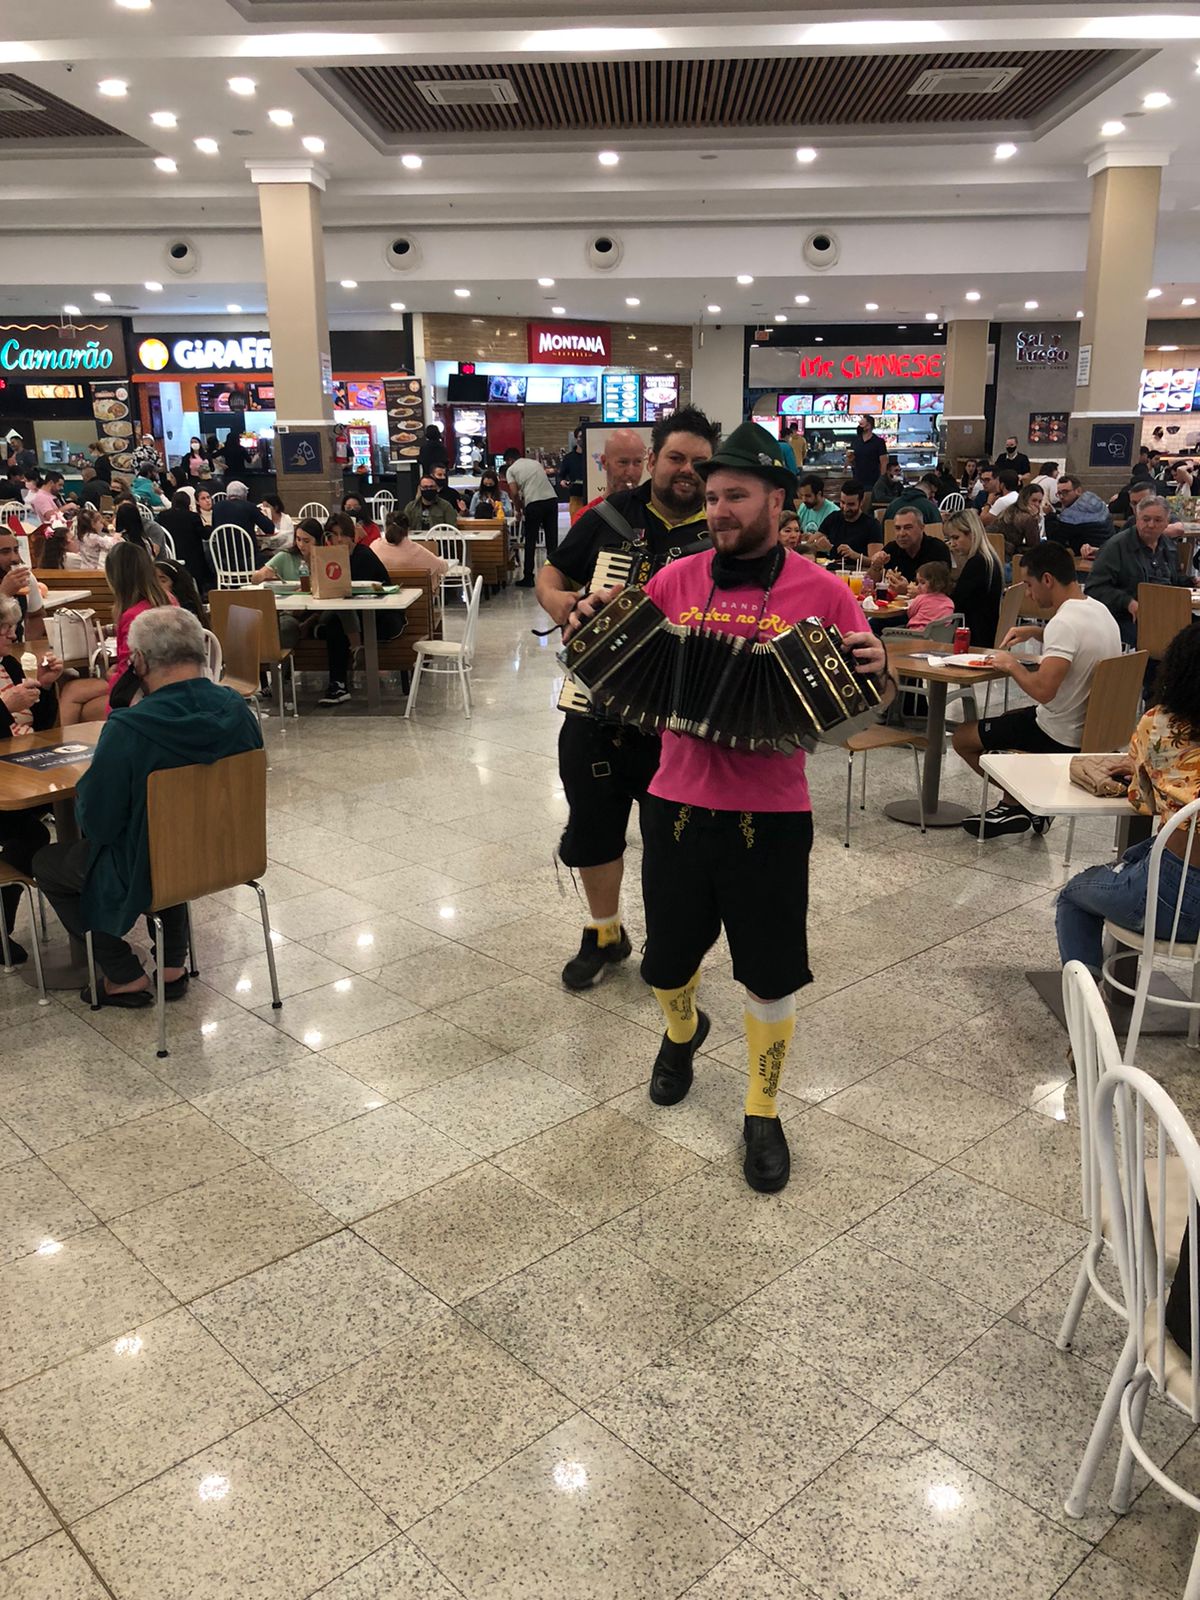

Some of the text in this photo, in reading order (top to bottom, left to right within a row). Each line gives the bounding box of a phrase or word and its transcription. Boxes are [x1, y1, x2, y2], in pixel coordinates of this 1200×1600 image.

[539, 332, 605, 356] MONTANA
[1016, 331, 1044, 348] Sal
[0, 338, 114, 370] Camarão
[841, 353, 943, 379] CHINESE
[679, 606, 732, 624] Pedra
[735, 614, 756, 624] no
